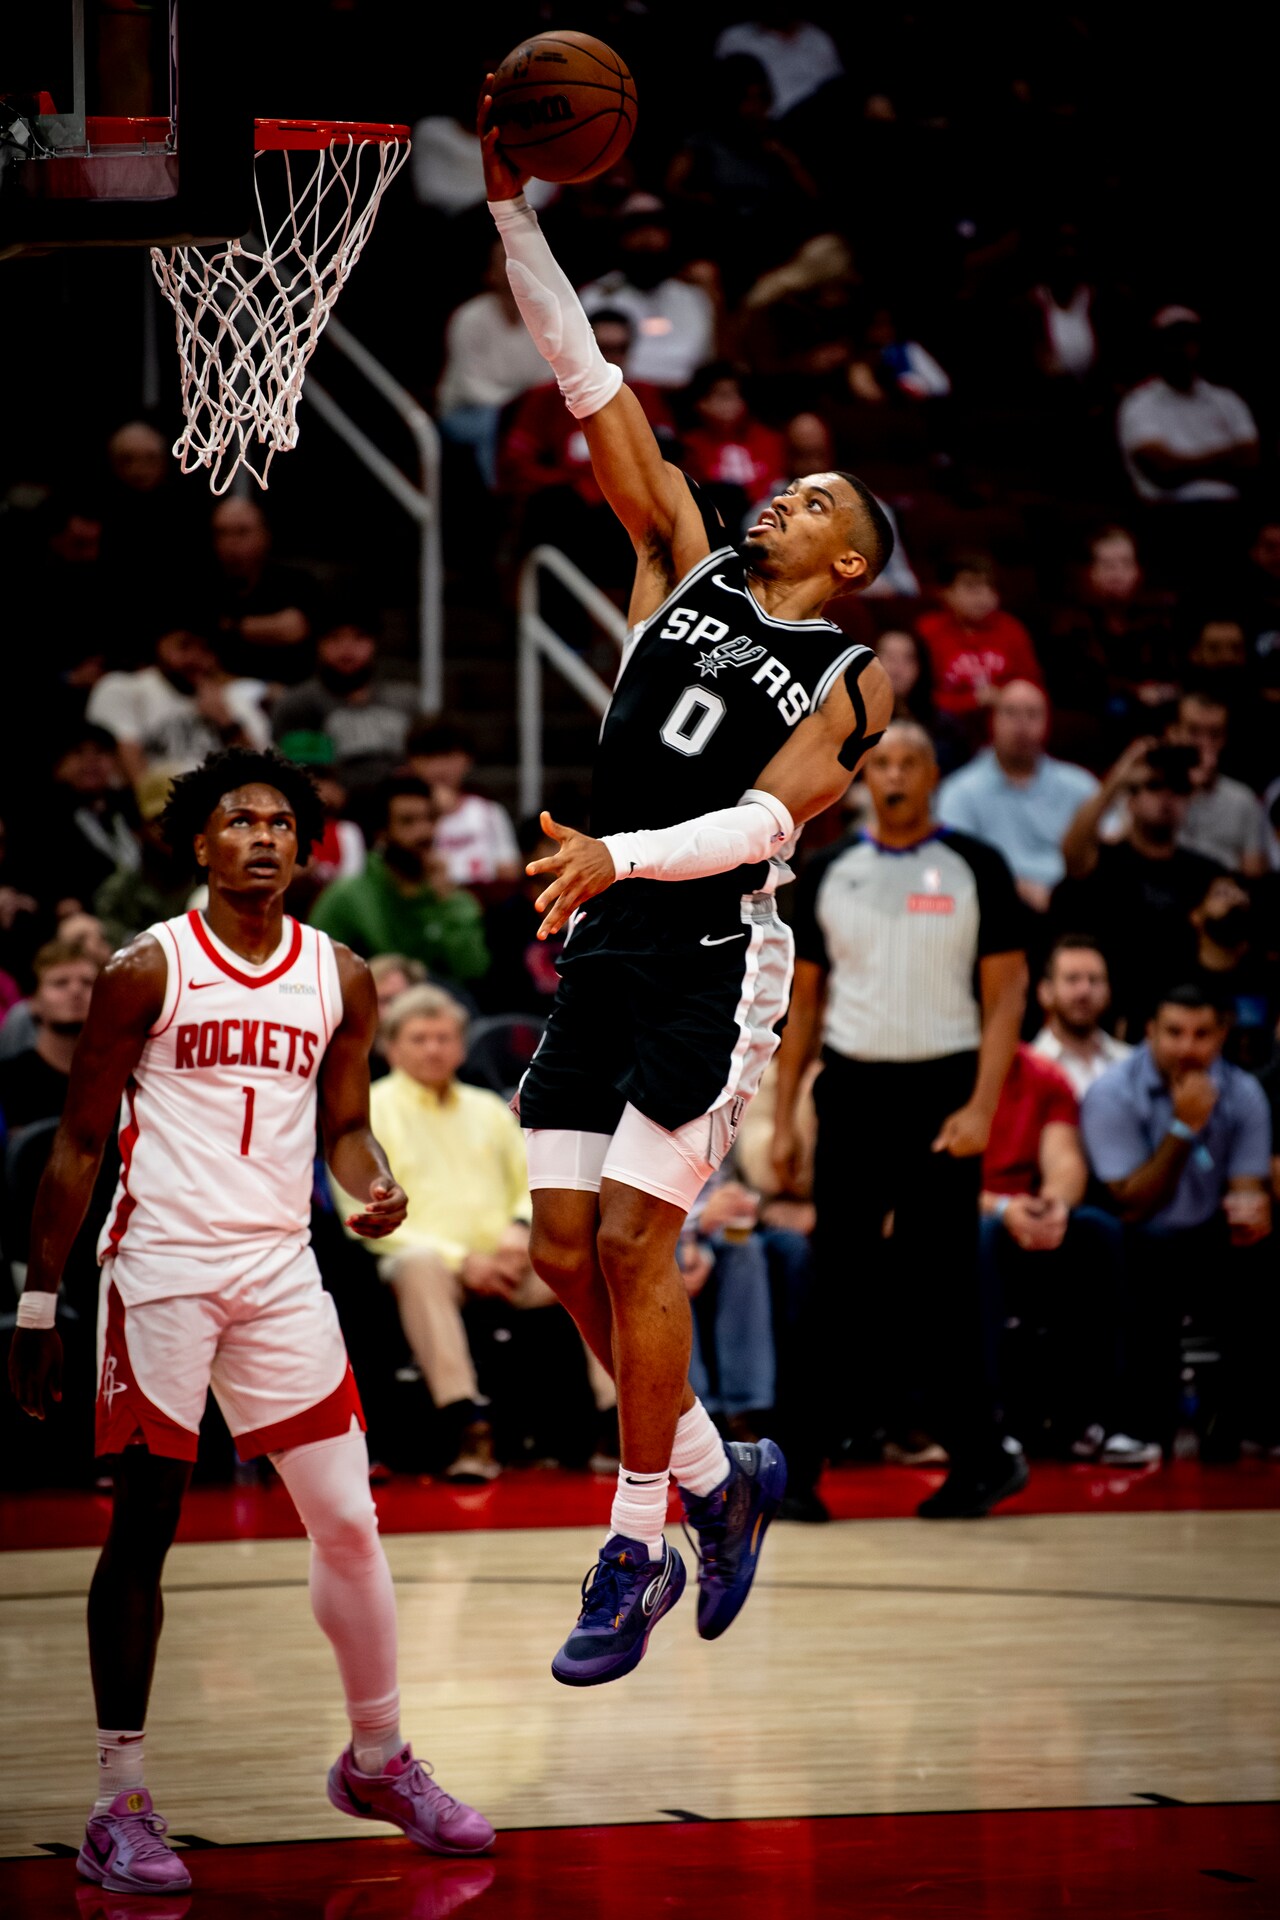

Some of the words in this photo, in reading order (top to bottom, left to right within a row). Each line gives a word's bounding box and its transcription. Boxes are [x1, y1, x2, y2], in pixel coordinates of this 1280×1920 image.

[660, 607, 811, 727] SPURS
[659, 683, 728, 757] 0
[175, 1019, 319, 1079] ROCKETS
[240, 1086, 256, 1156] 1
